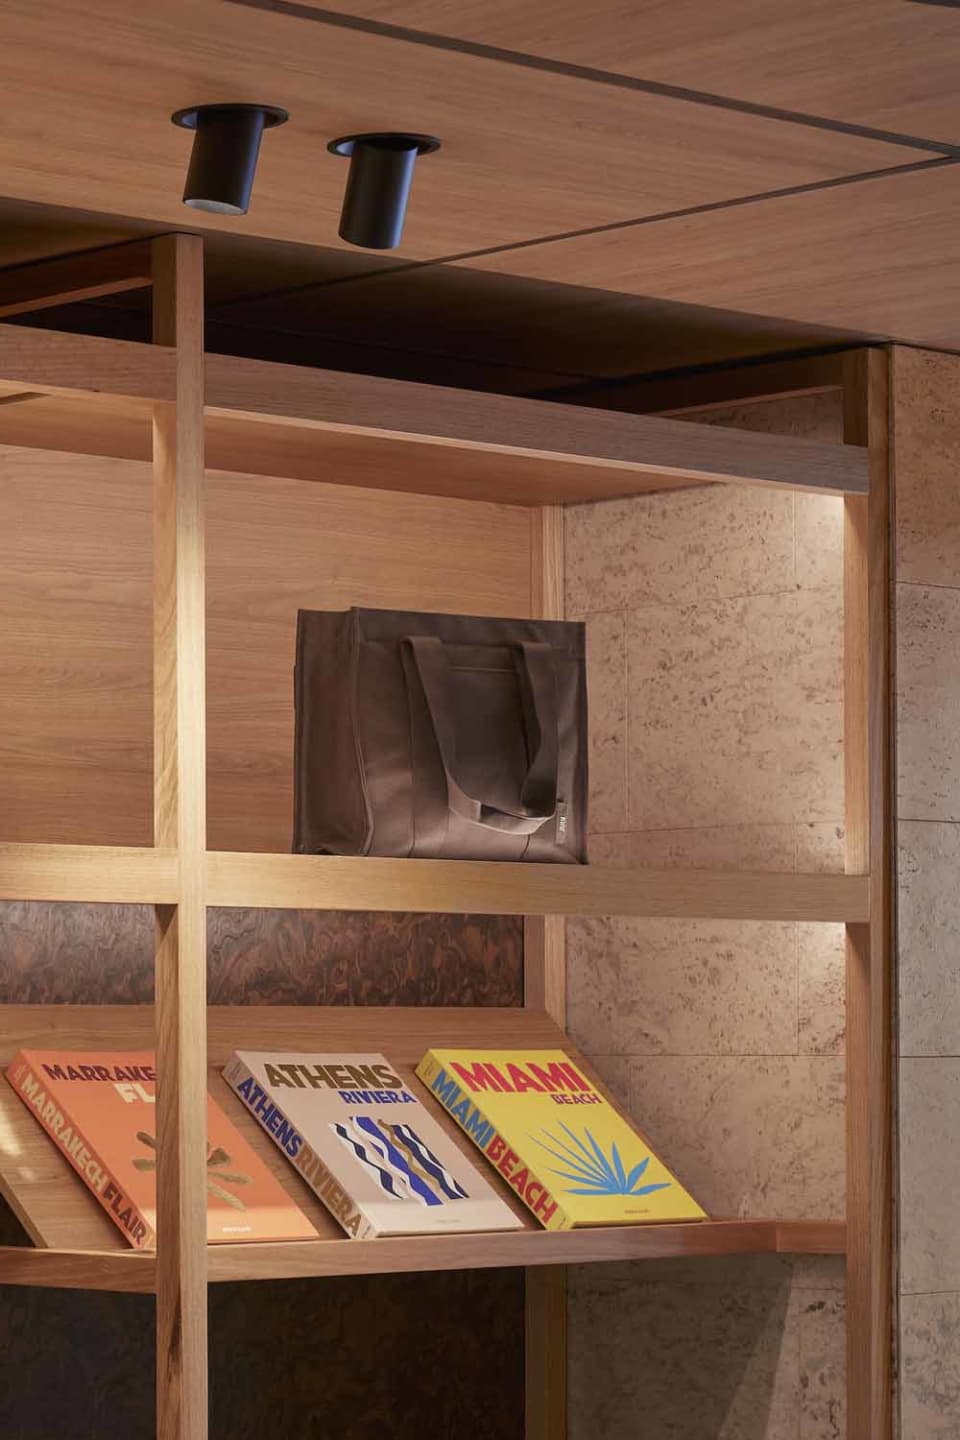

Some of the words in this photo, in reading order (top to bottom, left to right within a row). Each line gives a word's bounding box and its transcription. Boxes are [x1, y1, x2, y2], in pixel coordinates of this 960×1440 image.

[41, 1063, 157, 1081] MARRAKE
[264, 1063, 404, 1089] ATHENS
[449, 1062, 592, 1092] MIAMI
[338, 1090, 417, 1105] RIVIERA
[550, 1094, 603, 1105] BEACH
[20, 1073, 109, 1193] MARRAKECH
[103, 1181, 147, 1246] FLAIR
[237, 1077, 302, 1158] ATHENS
[294, 1144, 362, 1238] RIVIERA
[431, 1069, 496, 1150] MIAMI
[486, 1134, 559, 1225] BEACH
